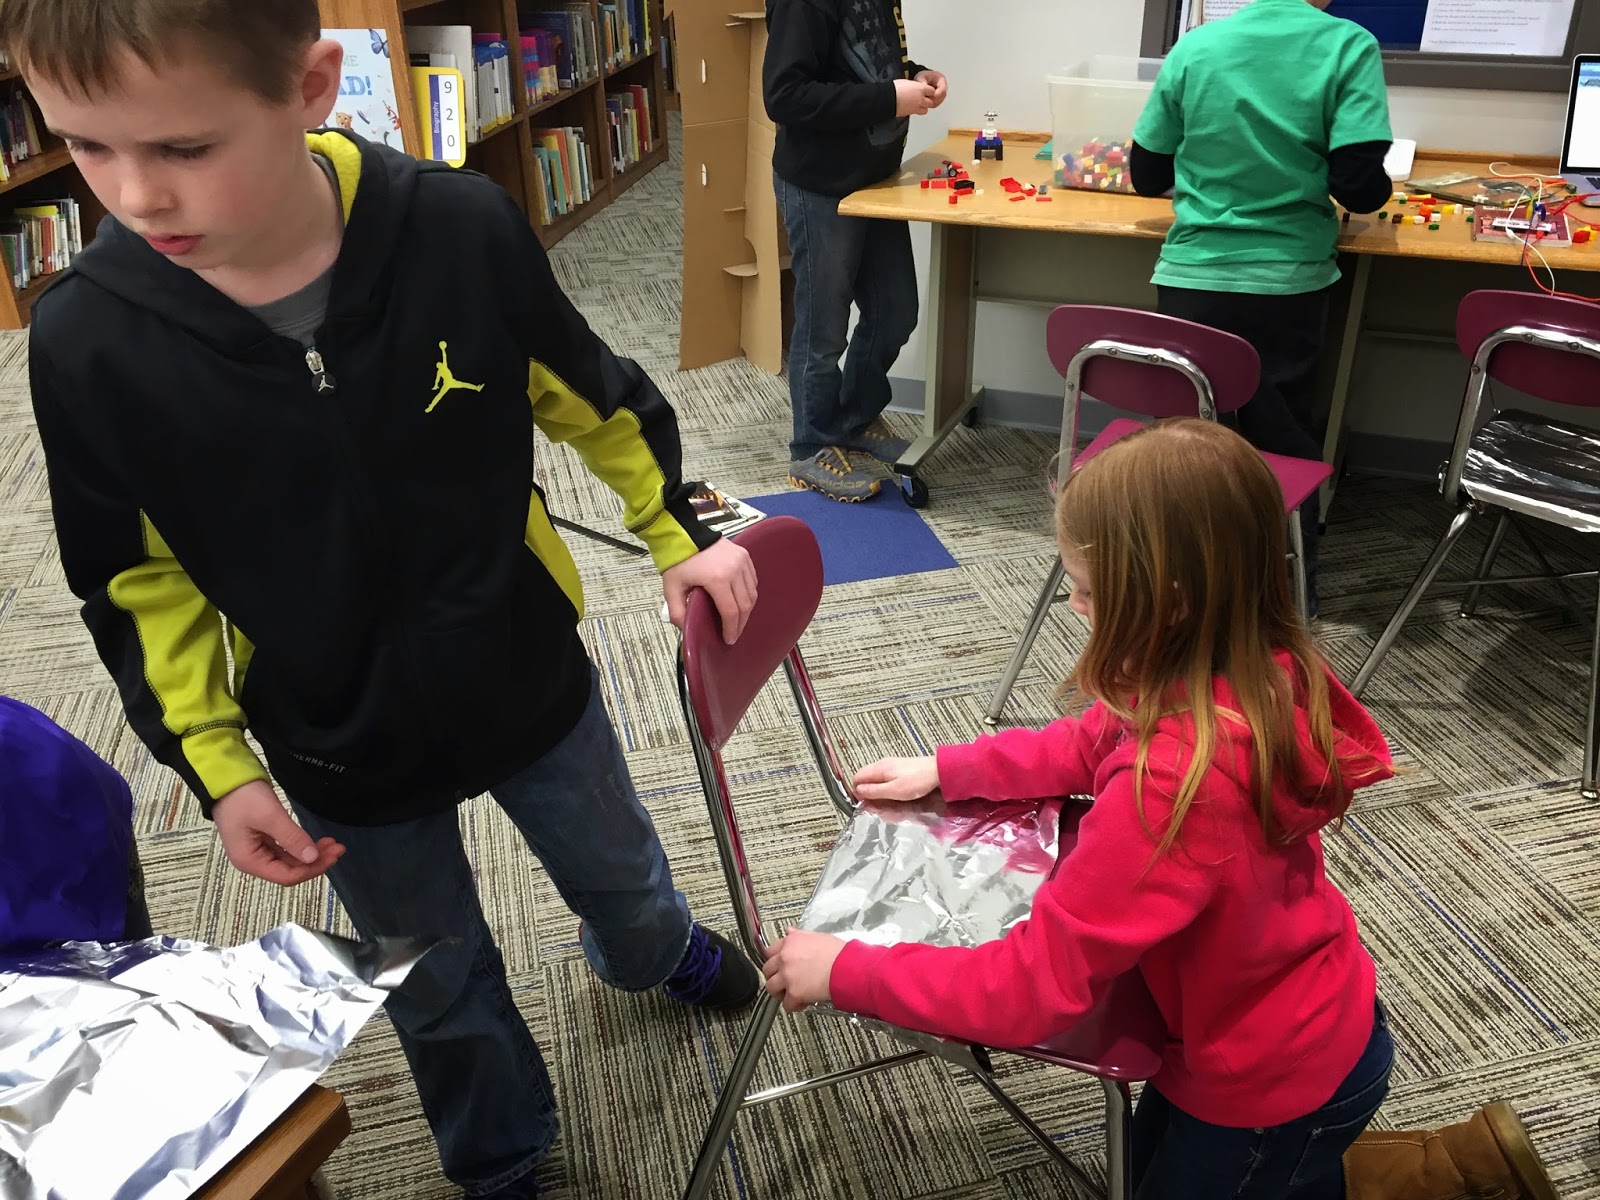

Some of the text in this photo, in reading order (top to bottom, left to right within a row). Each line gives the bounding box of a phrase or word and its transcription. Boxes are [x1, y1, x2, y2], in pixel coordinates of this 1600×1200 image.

[444, 81, 452, 94] 9
[445, 108, 454, 121] 2
[447, 134, 455, 148] 0
[289, 752, 346, 773] HERMA-FIT
